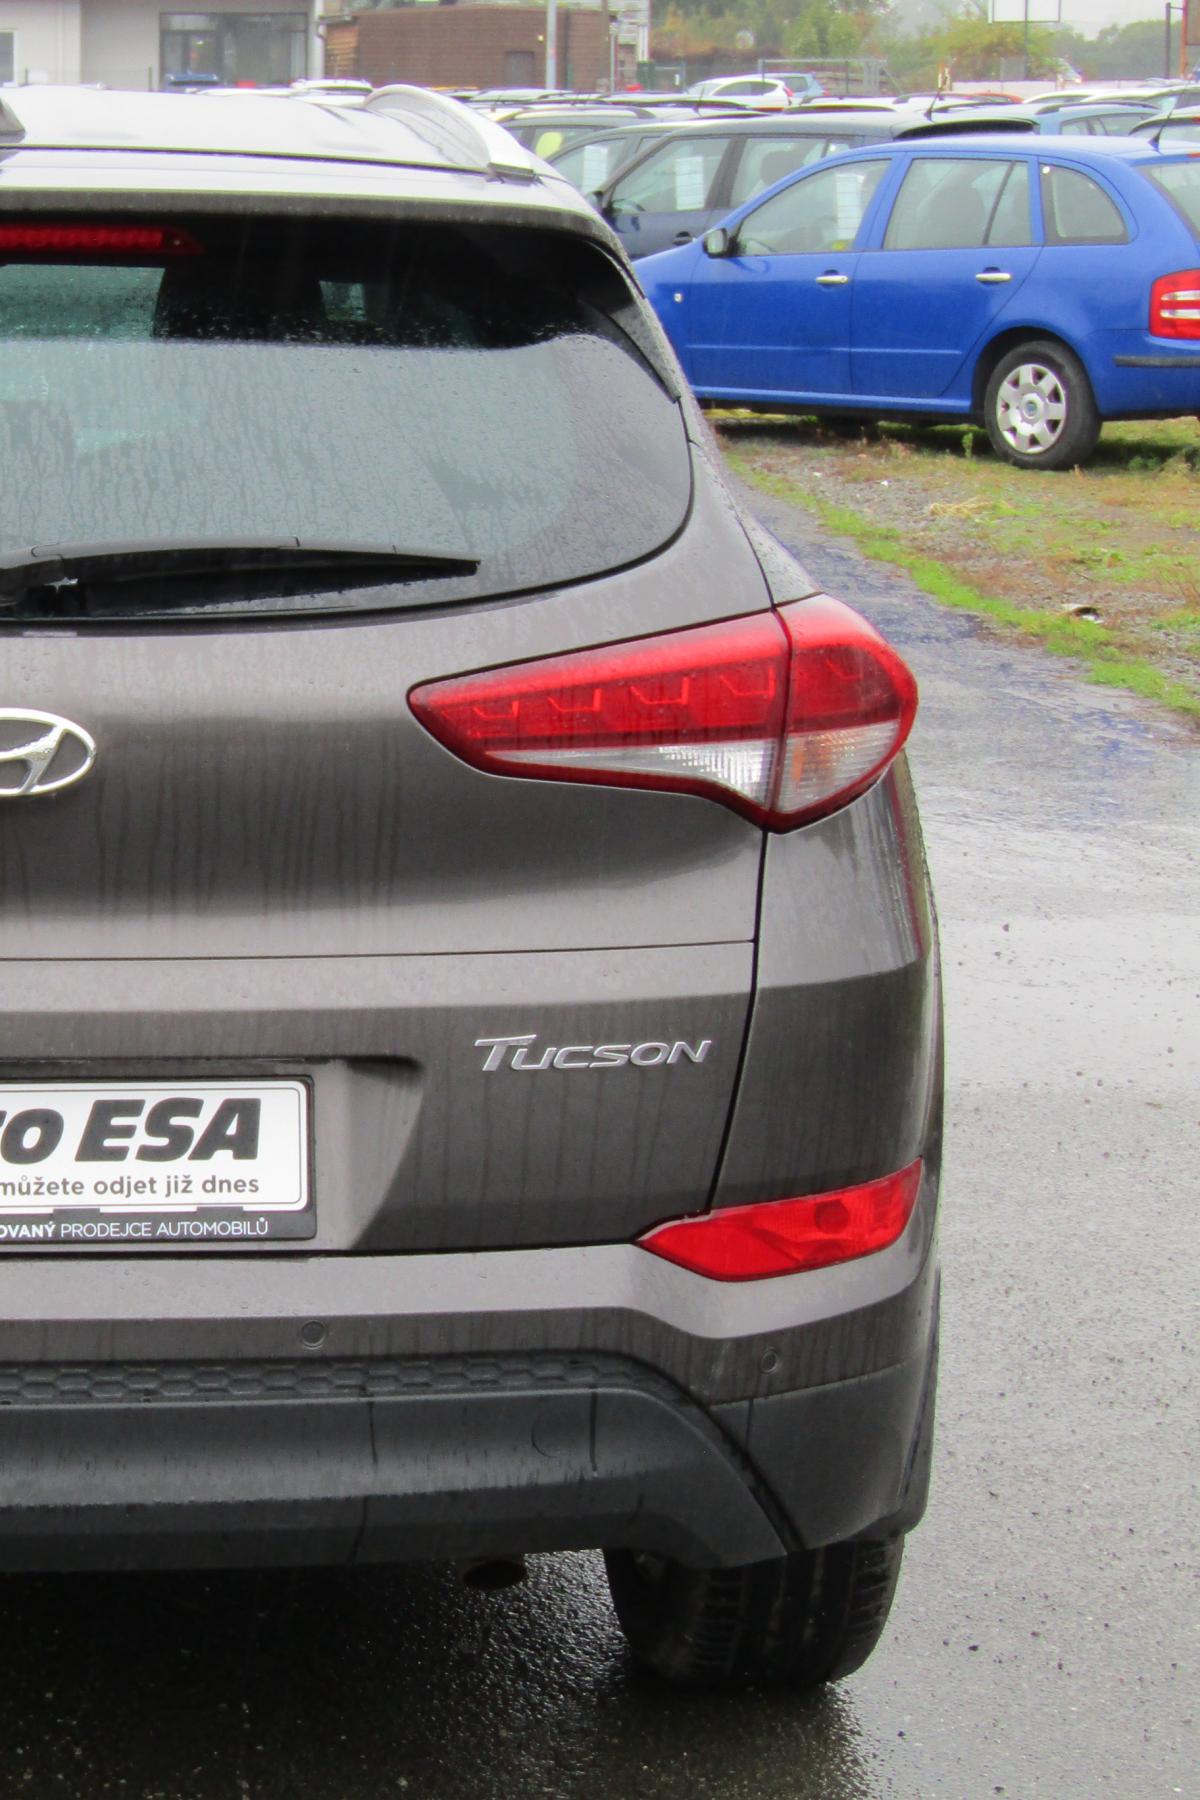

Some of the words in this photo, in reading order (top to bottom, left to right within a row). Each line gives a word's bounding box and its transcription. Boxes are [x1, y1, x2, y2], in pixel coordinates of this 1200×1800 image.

[473, 1033, 712, 1072] TUCSON
[74, 1096, 262, 1163] ESA
[93, 1176, 158, 1199] odjet
[164, 1174, 194, 1199] již
[201, 1174, 260, 1194] dnes
[60, 1221, 152, 1238] PRODEJCE
[155, 1217, 269, 1238] AUTOMOBILŮ
